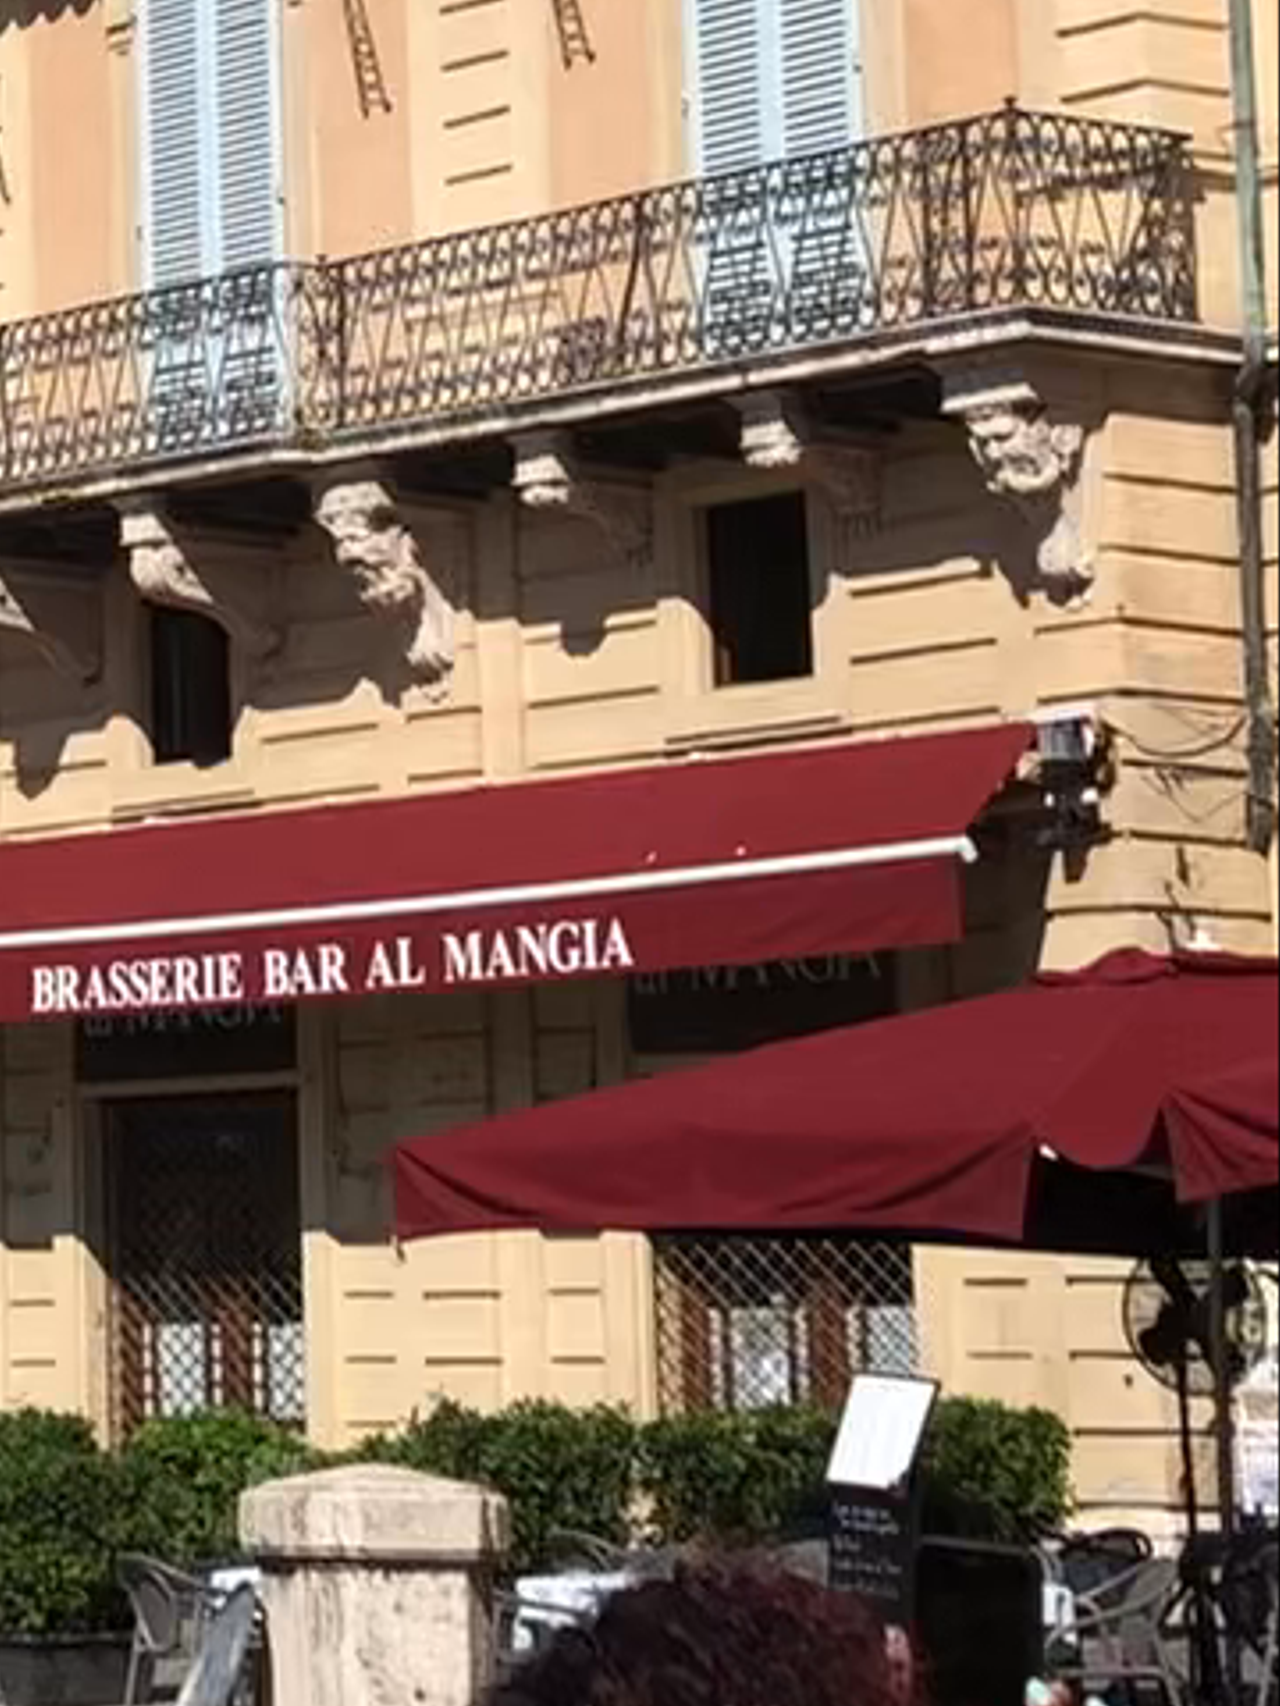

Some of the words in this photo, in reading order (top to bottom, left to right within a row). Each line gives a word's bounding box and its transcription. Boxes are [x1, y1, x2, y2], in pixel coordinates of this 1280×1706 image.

[31, 953, 243, 1012] BRASSERIE
[263, 943, 348, 997] BAR
[365, 936, 426, 989] AL
[443, 918, 634, 982] MANGIA
